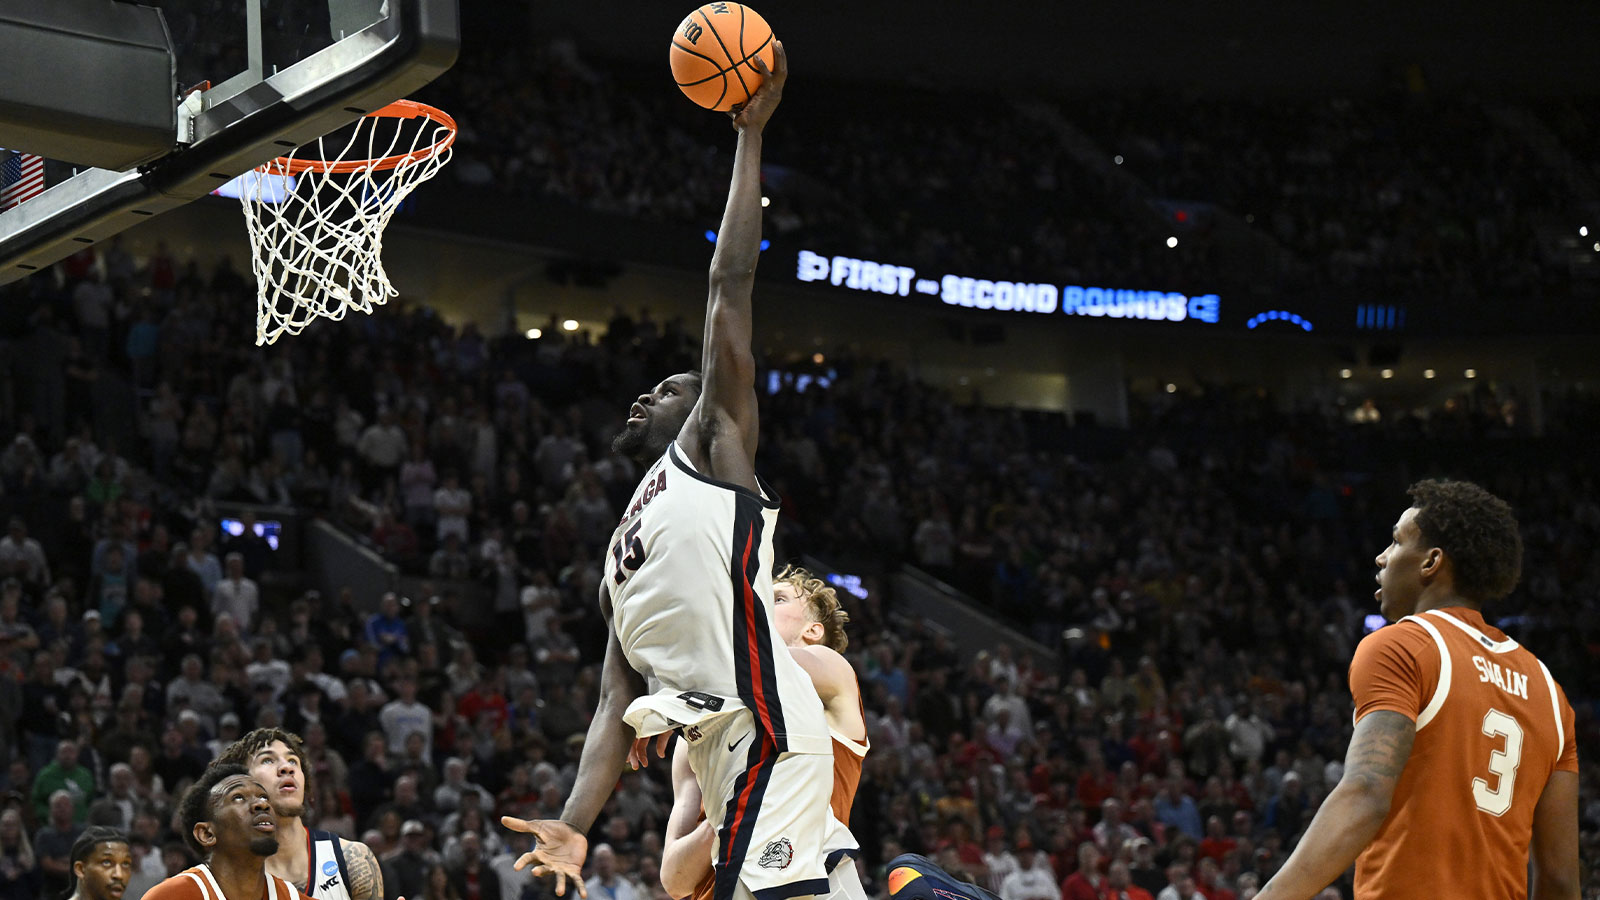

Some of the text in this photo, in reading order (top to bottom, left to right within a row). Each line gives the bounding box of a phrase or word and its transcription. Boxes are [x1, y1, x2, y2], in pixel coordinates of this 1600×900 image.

[831, 256, 916, 297] FIRST
[941, 274, 1058, 313] SECOND
[1063, 286, 1188, 322] ROUNDS
[612, 517, 646, 586] 15
[1472, 655, 1528, 700] SWAIN
[1472, 707, 1524, 817] 3
